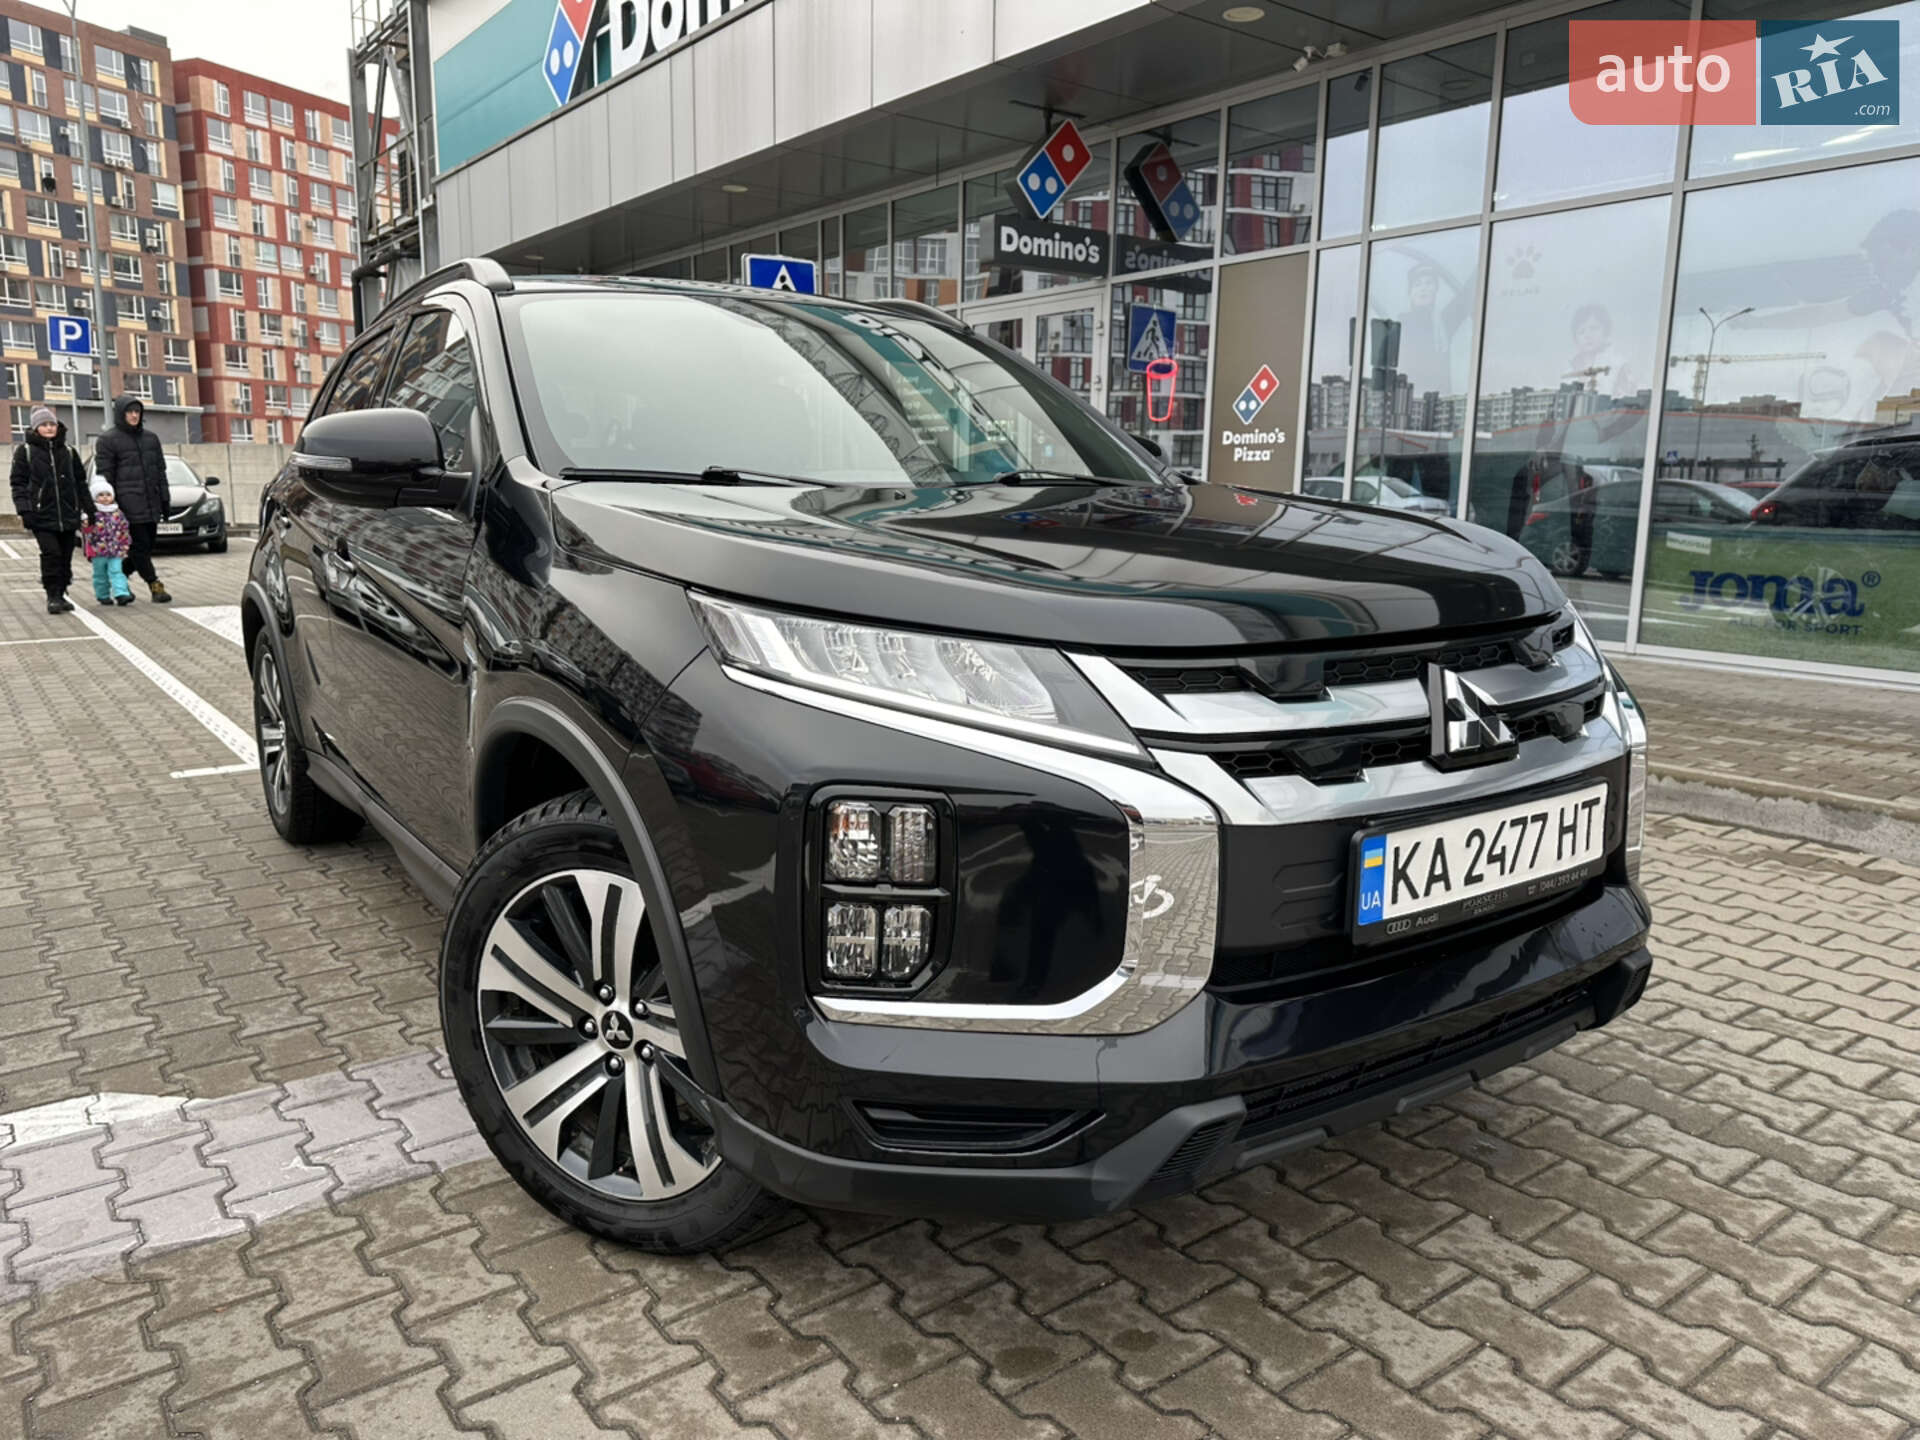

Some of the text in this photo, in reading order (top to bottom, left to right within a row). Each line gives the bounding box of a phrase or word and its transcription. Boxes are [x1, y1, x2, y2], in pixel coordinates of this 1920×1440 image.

[1000, 225, 1100, 264] Domino's
[59, 320, 82, 350] P
[1222, 427, 1286, 445] Domino's
[1233, 446, 1271, 462] Pizza
[1804, 622, 1863, 636] SPORT
[1390, 796, 1601, 905] KA 2477 HT
[1361, 891, 1381, 910] UA
[1416, 912, 1439, 928] Audi
